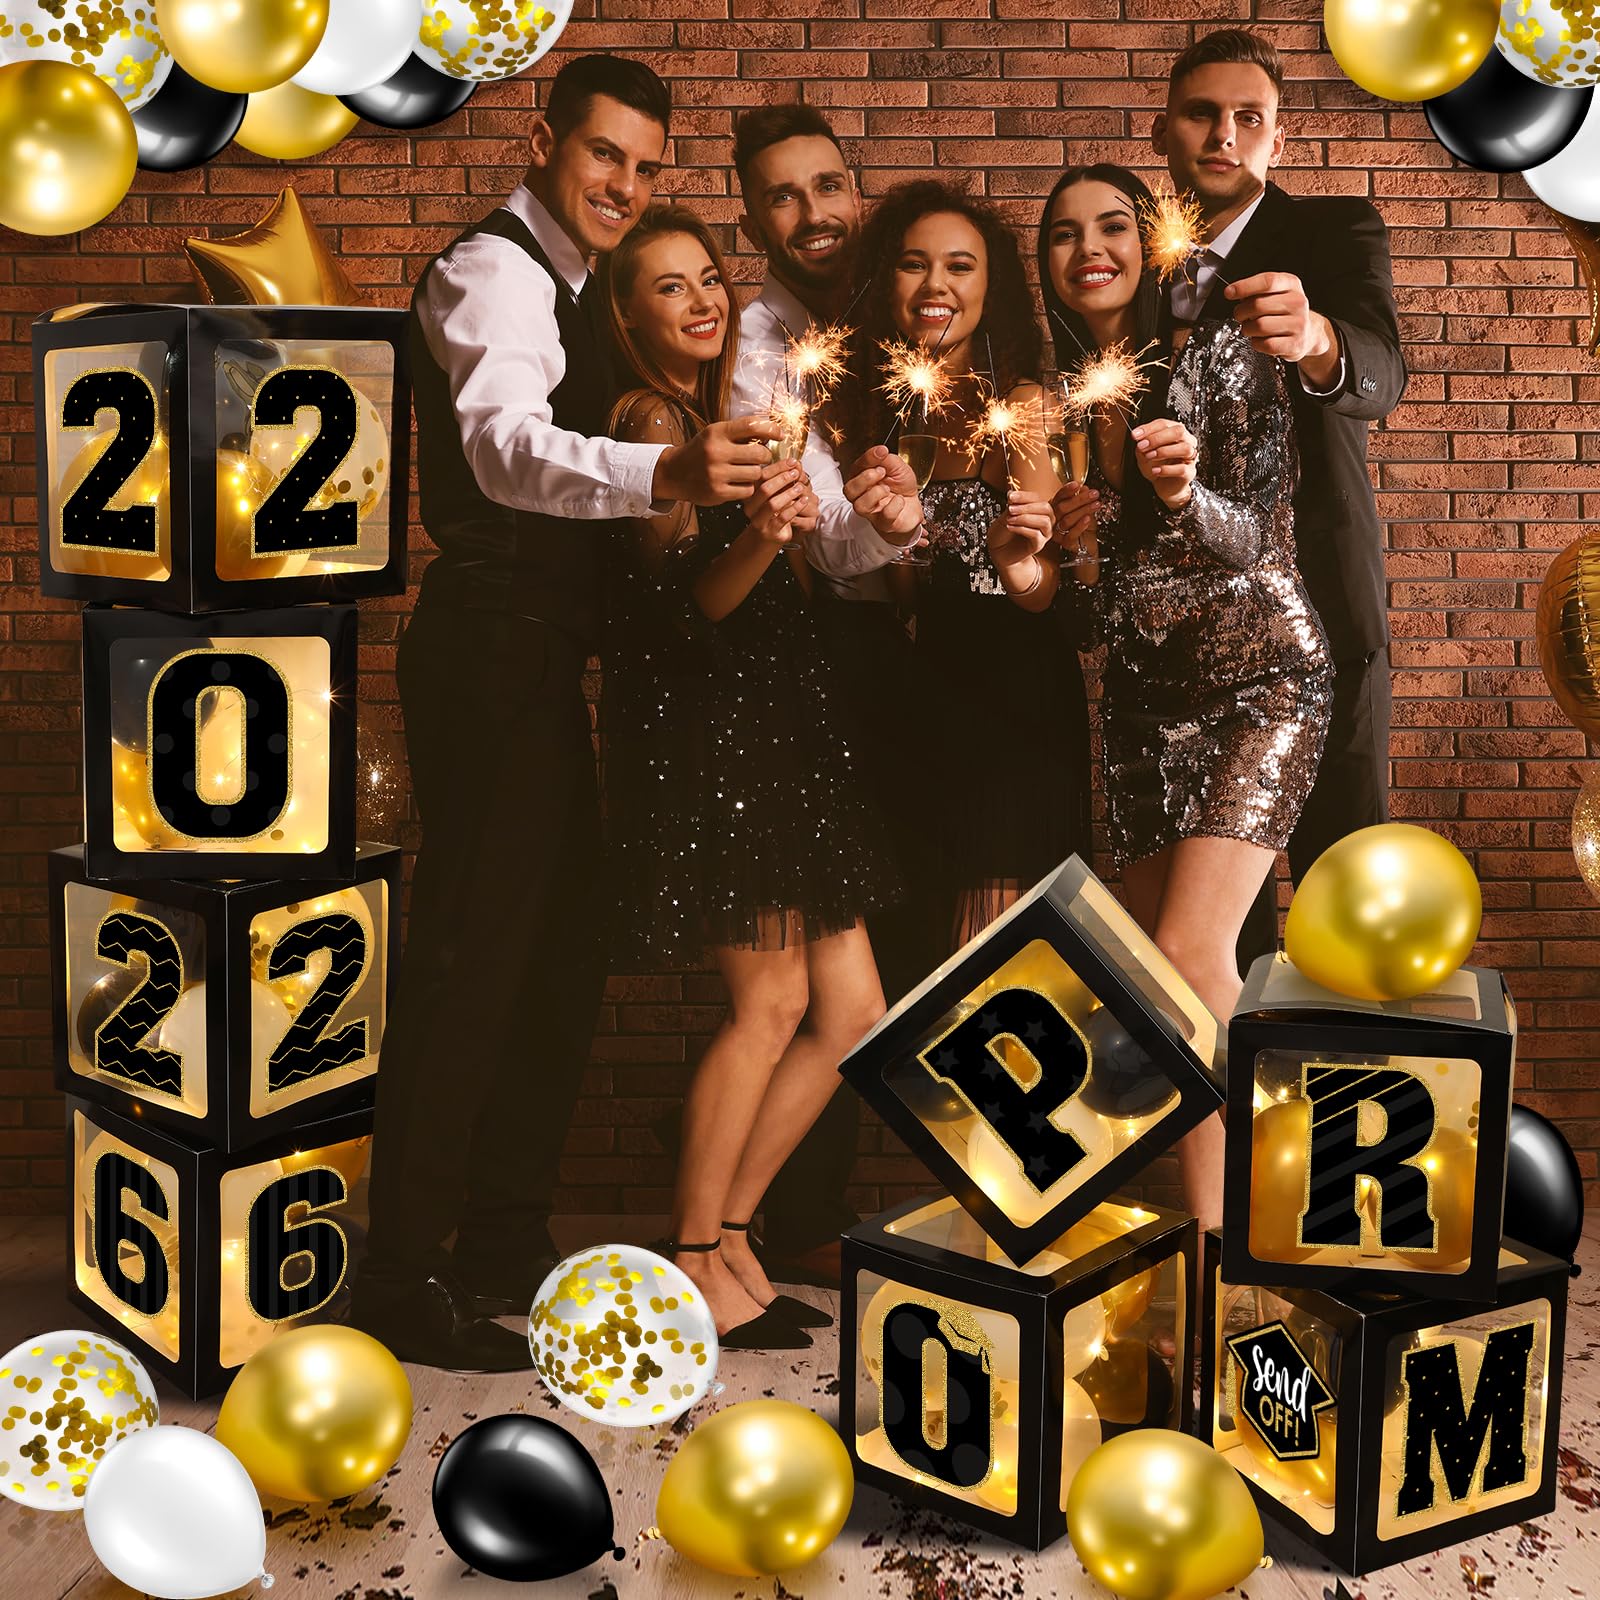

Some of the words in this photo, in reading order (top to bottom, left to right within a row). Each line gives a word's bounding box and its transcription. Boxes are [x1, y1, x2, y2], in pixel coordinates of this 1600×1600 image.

[60, 366, 159, 557] 2
[251, 363, 360, 559] 2
[95, 908, 184, 1101] 2
[265, 910, 371, 1099] 2
[916, 984, 1092, 1198] P
[91, 1149, 171, 1318] 6
[244, 1165, 348, 1323] 6
[1297, 1062, 1439, 1253] R
[879, 1298, 994, 1491] O
[1259, 1395, 1299, 1447] OFF!
[1393, 1320, 1538, 1520] M
